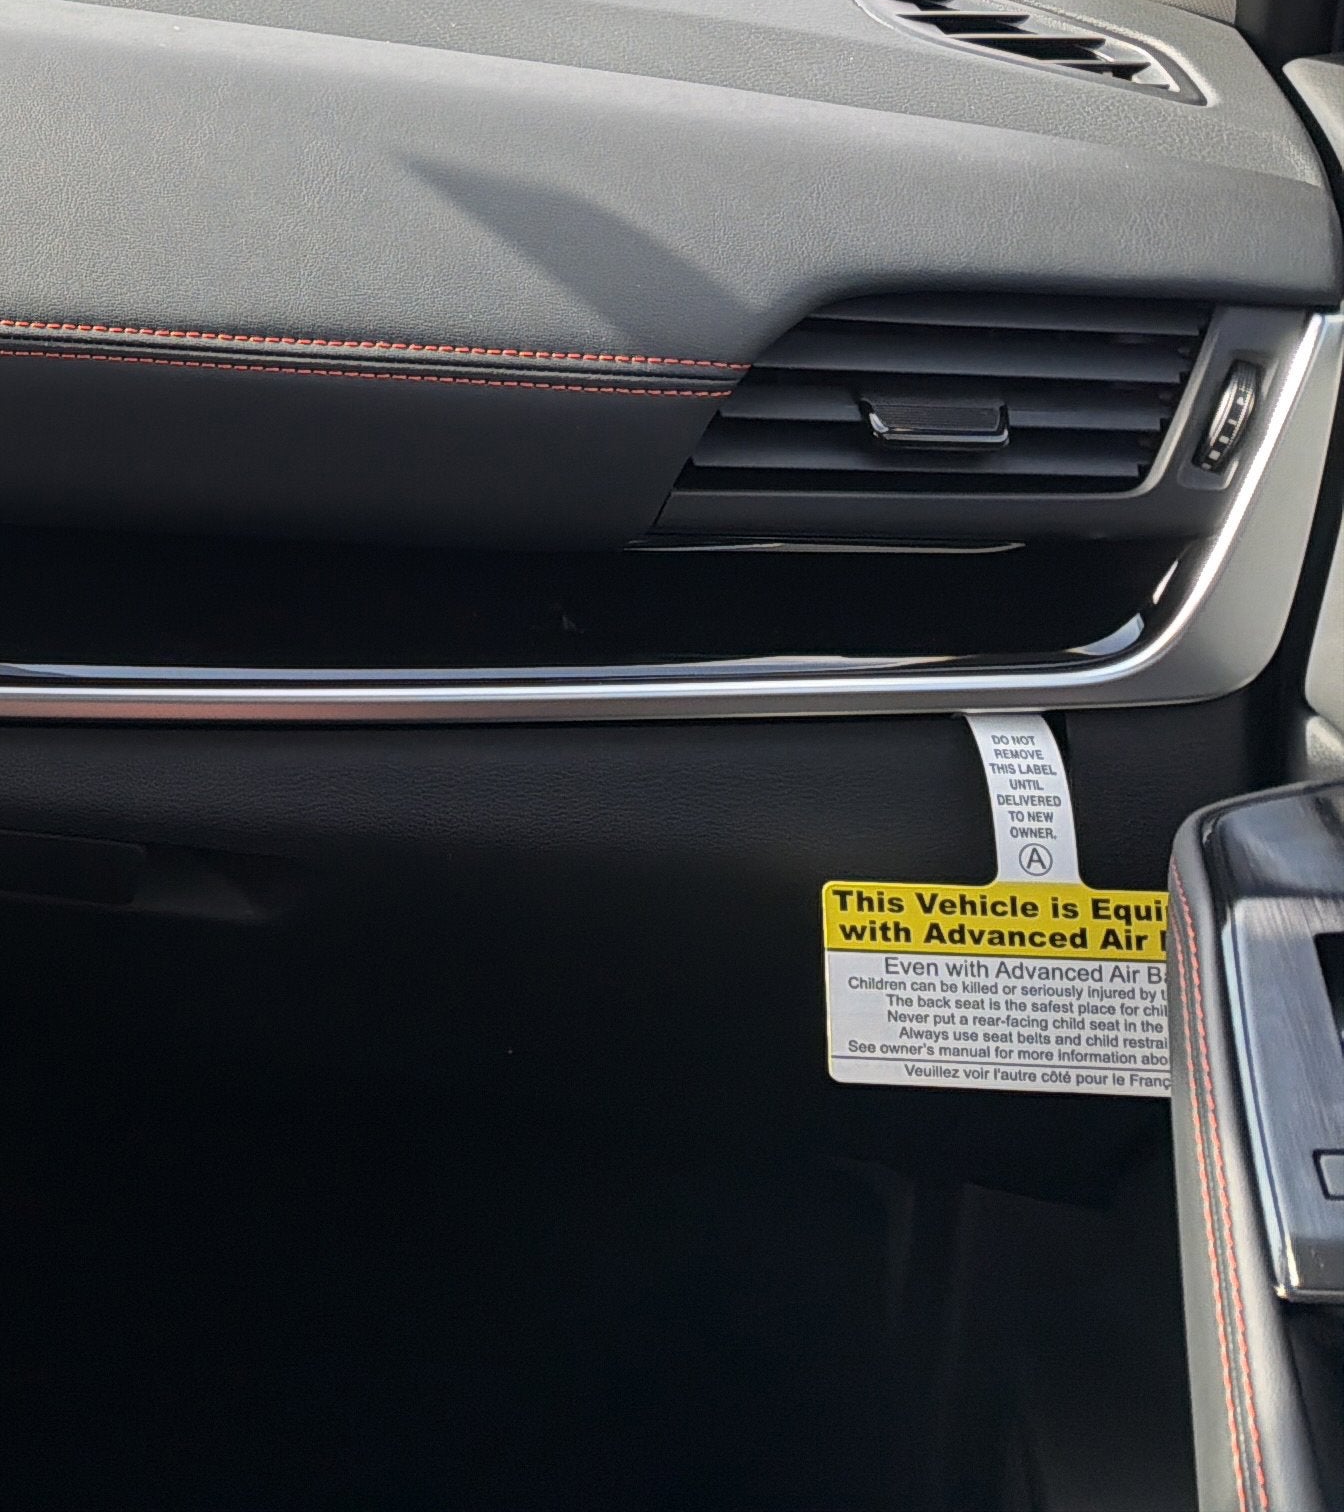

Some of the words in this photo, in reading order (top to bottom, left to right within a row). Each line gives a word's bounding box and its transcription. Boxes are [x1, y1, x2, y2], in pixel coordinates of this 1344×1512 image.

[991, 734, 1010, 745] DO
[1011, 735, 1036, 746] NOT
[994, 748, 1045, 760] REMOVE
[989, 762, 1017, 775] THIS
[1018, 763, 1058, 776] LABEL
[1009, 778, 1045, 791] UNTIL
[996, 793, 1062, 807] DELIVERED
[1008, 810, 1025, 823] TO
[1027, 810, 1054, 823] NEW
[1009, 826, 1058, 840] OWNER.
[1026, 847, 1047, 870] A
[832, 889, 905, 913] This
[914, 891, 1040, 918] Vehicle
[1050, 896, 1079, 919] is
[1090, 897, 1169, 926] Equi
[838, 919, 912, 943] with
[923, 921, 1088, 949] Advanced
[1099, 927, 1149, 951] Air
[884, 956, 939, 977] Even
[945, 959, 989, 979] with
[994, 960, 1104, 983] Advanced
[1109, 964, 1141, 984] Air
[847, 975, 907, 991] Children
[909, 981, 937, 992] can
[939, 979, 958, 994] be
[961, 980, 999, 995] killed
[1002, 984, 1018, 996] or
[1020, 984, 1084, 1001] seriously
[1087, 985, 1136, 1002] injured
[1139, 987, 1157, 1004] by
[886, 993, 914, 1007] The
[917, 994, 952, 1009] back
[954, 997, 986, 1011] seat
[988, 998, 1001, 1011] is
[1004, 998, 1028, 1012] the
[1030, 999, 1075, 1014] safest
[1077, 1001, 1117, 1016] place
[1119, 1002, 1140, 1016] for
[887, 1009, 930, 1024] Never
[933, 1012, 956, 1027] put
[959, 1015, 969, 1025] a
[972, 1014, 1049, 1032] rear-facing
[1052, 1016, 1086, 1031] child
[1089, 1019, 1121, 1032] seat
[1124, 1019, 1137, 1032] in
[1140, 1020, 1164, 1033] the
[898, 1026, 950, 1043] Always
[952, 1030, 979, 1042] use
[982, 1030, 1014, 1044] seat
[1017, 1031, 1051, 1045] belts
[1054, 1032, 1082, 1046] and
[1085, 1033, 1119, 1048] child
[1122, 1037, 1168, 1050] restrai
[848, 1039, 876, 1054] See
[879, 1042, 935, 1056] owner's
[938, 1044, 991, 1059] manual
[994, 1045, 1014, 1059] for
[1017, 1050, 1054, 1062] more
[1057, 1048, 1137, 1065] information
[1141, 1052, 1169, 1066] abo
[904, 1063, 960, 1079] Veuillez
[963, 1066, 990, 1080] voir
[993, 1067, 1037, 1083] l'autre
[1040, 1070, 1072, 1084] côté
[1075, 1073, 1109, 1087] pour
[1112, 1072, 1125, 1086] le
[1129, 1073, 1172, 1090] Franç
